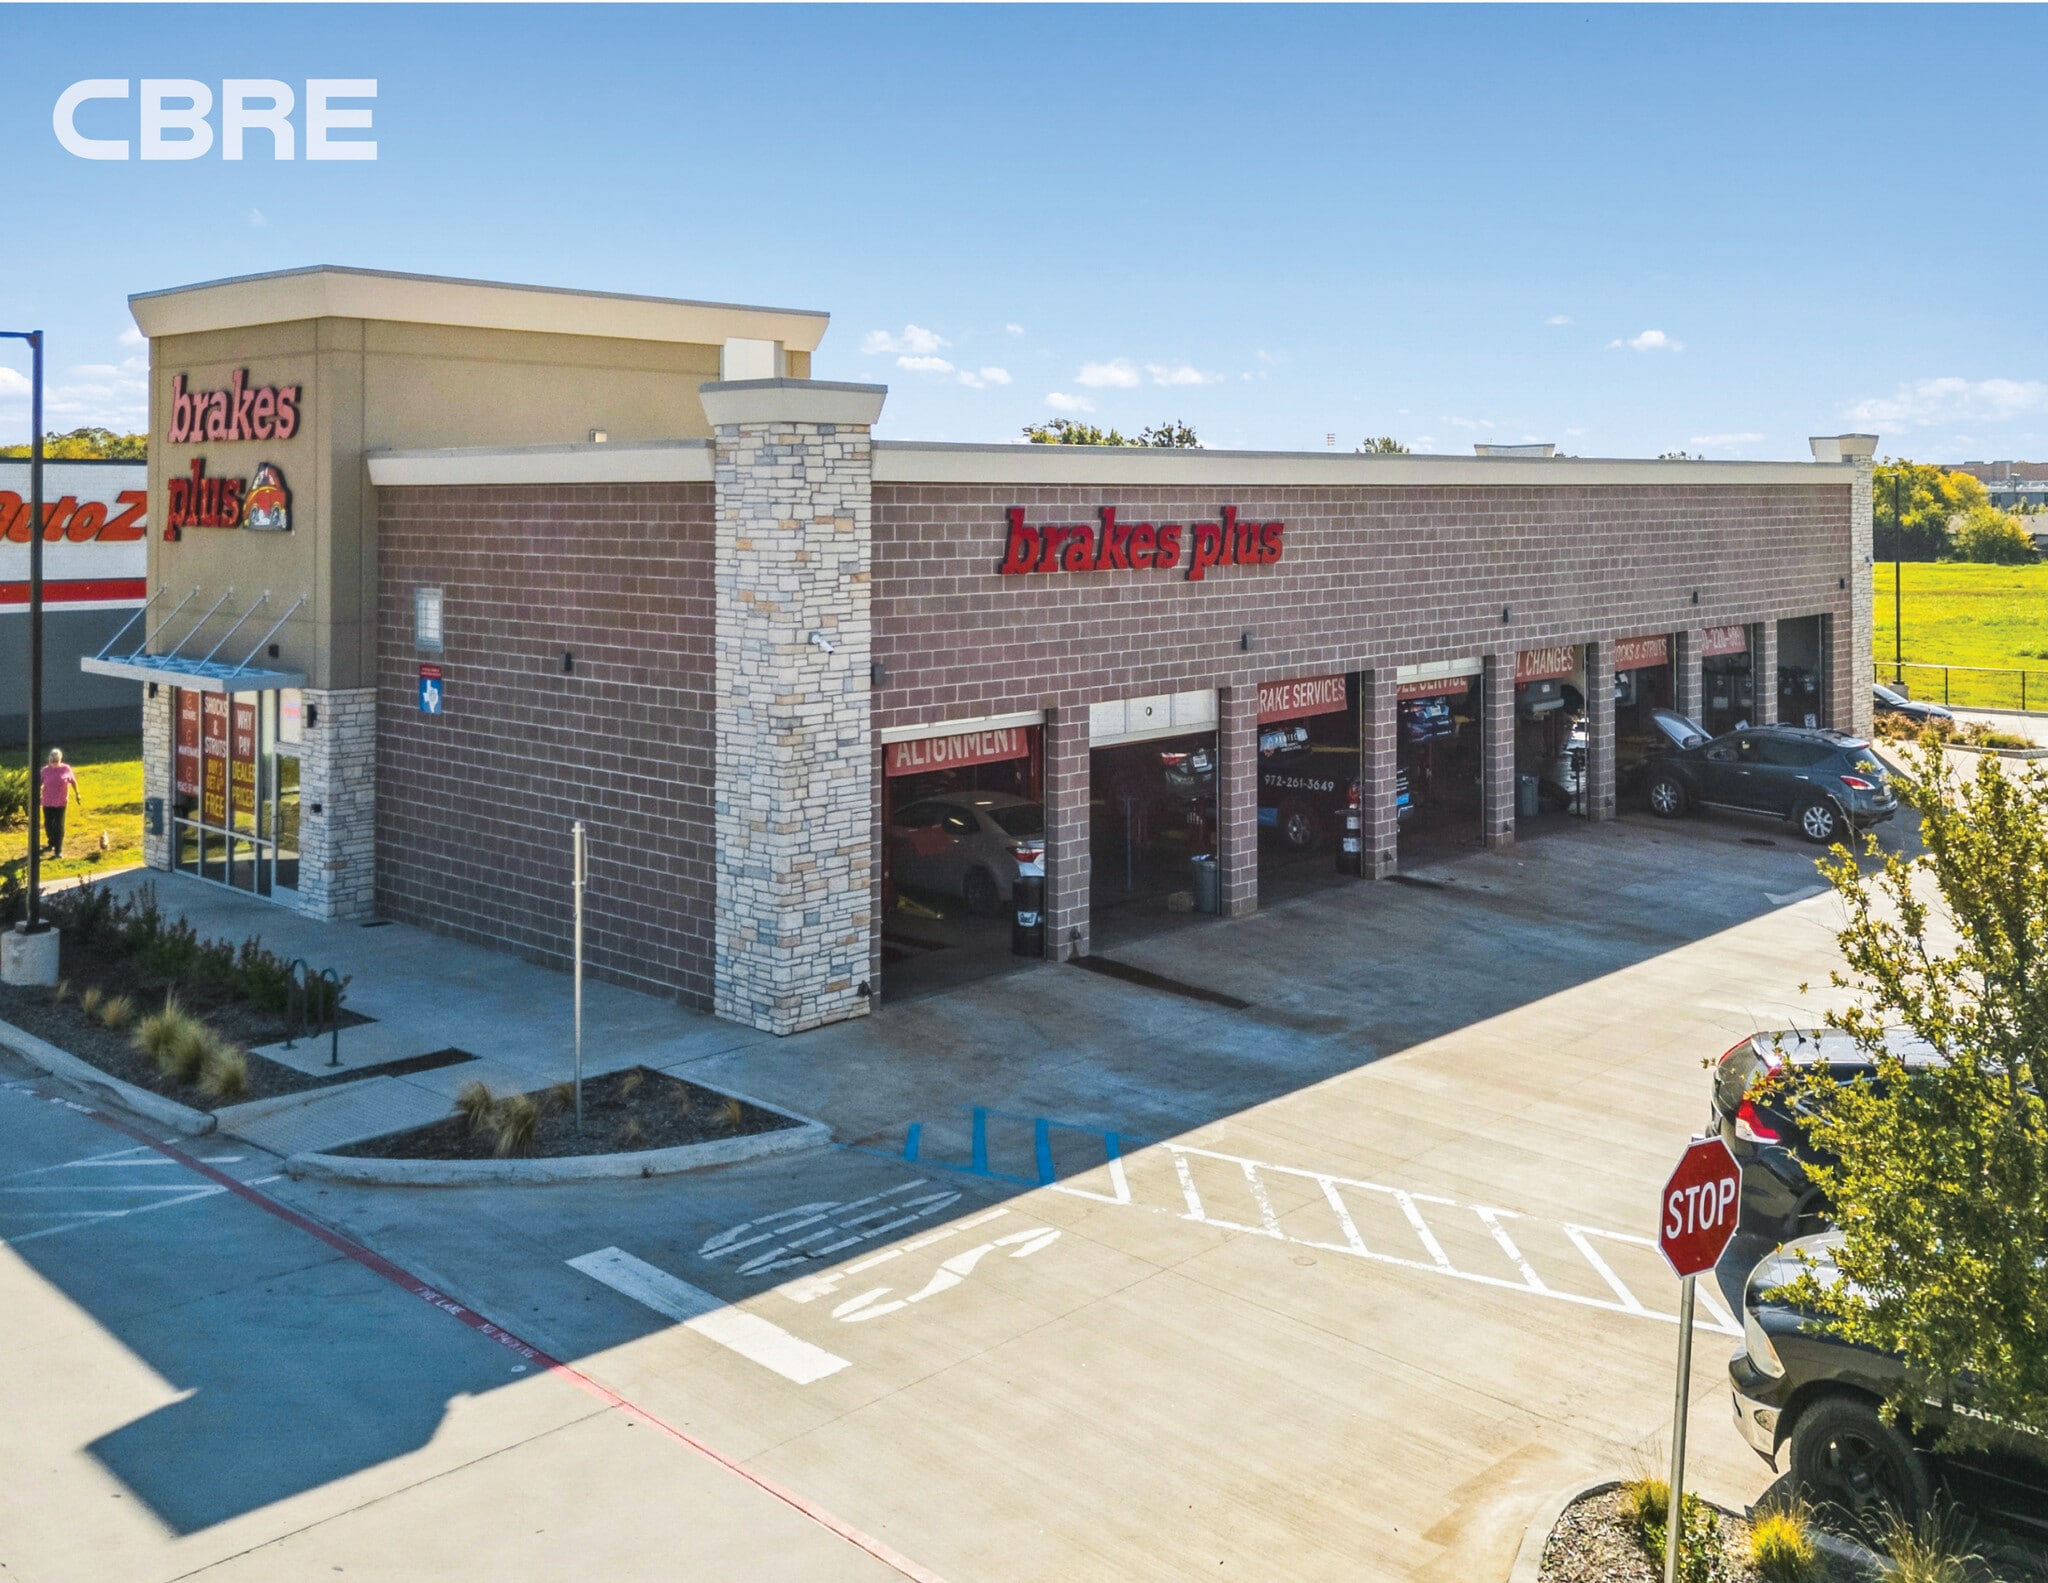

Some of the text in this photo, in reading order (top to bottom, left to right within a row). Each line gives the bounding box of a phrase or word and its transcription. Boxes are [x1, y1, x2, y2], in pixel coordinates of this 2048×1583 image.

[167, 368, 299, 443] brakes
[163, 458, 244, 542] plus
[1000, 505, 1285, 581] brakes plus
[1525, 646, 1574, 676] CHANGES
[1257, 677, 1345, 713] RAKE SERVICES
[237, 709, 252, 730] WHY
[238, 735, 250, 757] PAY
[896, 728, 1018, 767] ALIGNMENT
[1264, 774, 1335, 792] 972-261-3649
[205, 791, 224, 818] FREE
[1666, 1176, 1736, 1240] STOP
